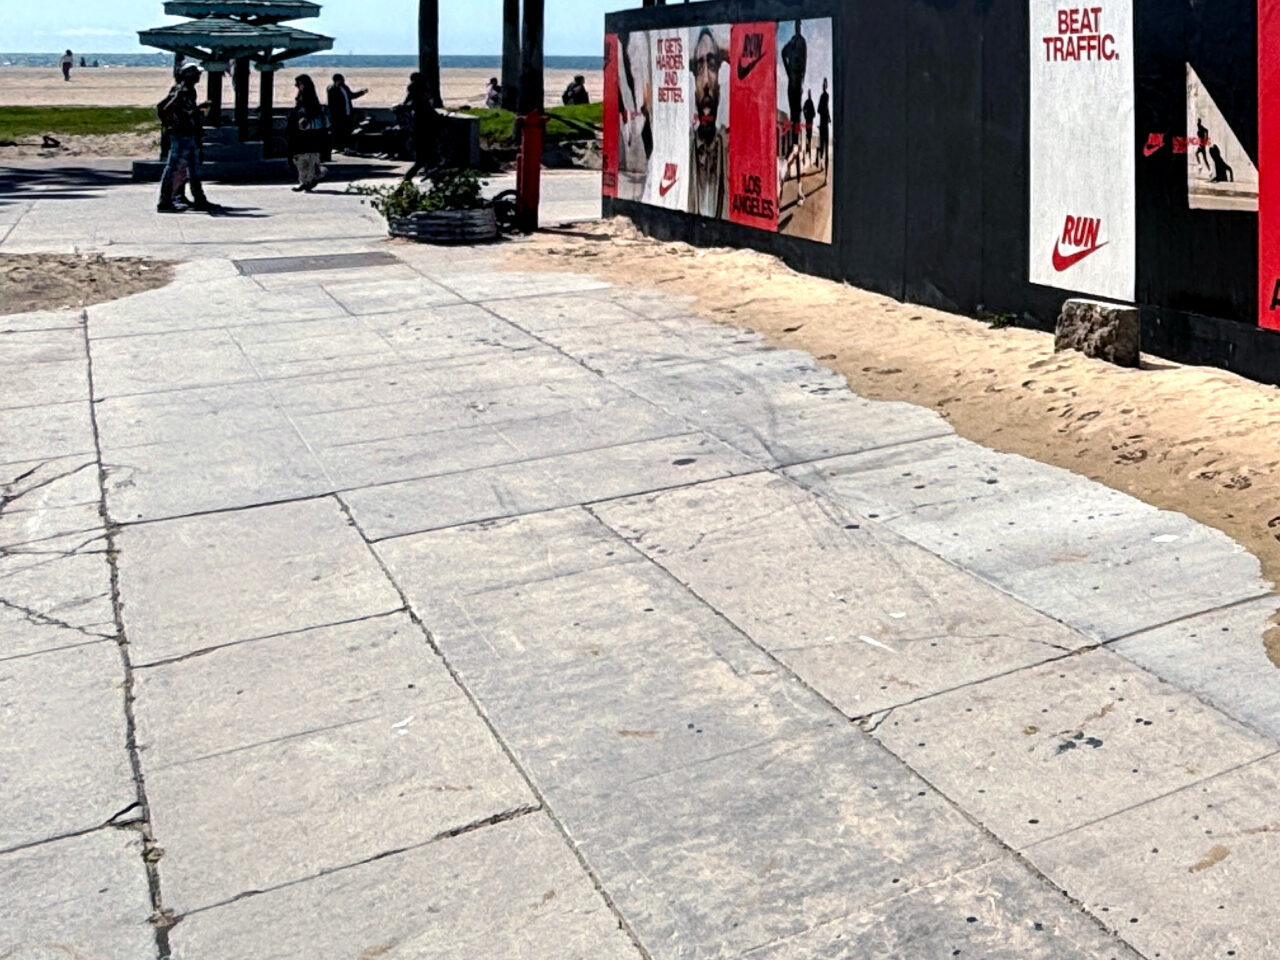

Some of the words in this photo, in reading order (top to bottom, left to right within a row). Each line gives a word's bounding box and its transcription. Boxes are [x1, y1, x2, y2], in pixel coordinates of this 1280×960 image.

[1058, 7, 1102, 34] BEAT
[1043, 34, 1119, 61] TRAFFIC.
[1062, 215, 1101, 247] RUN
